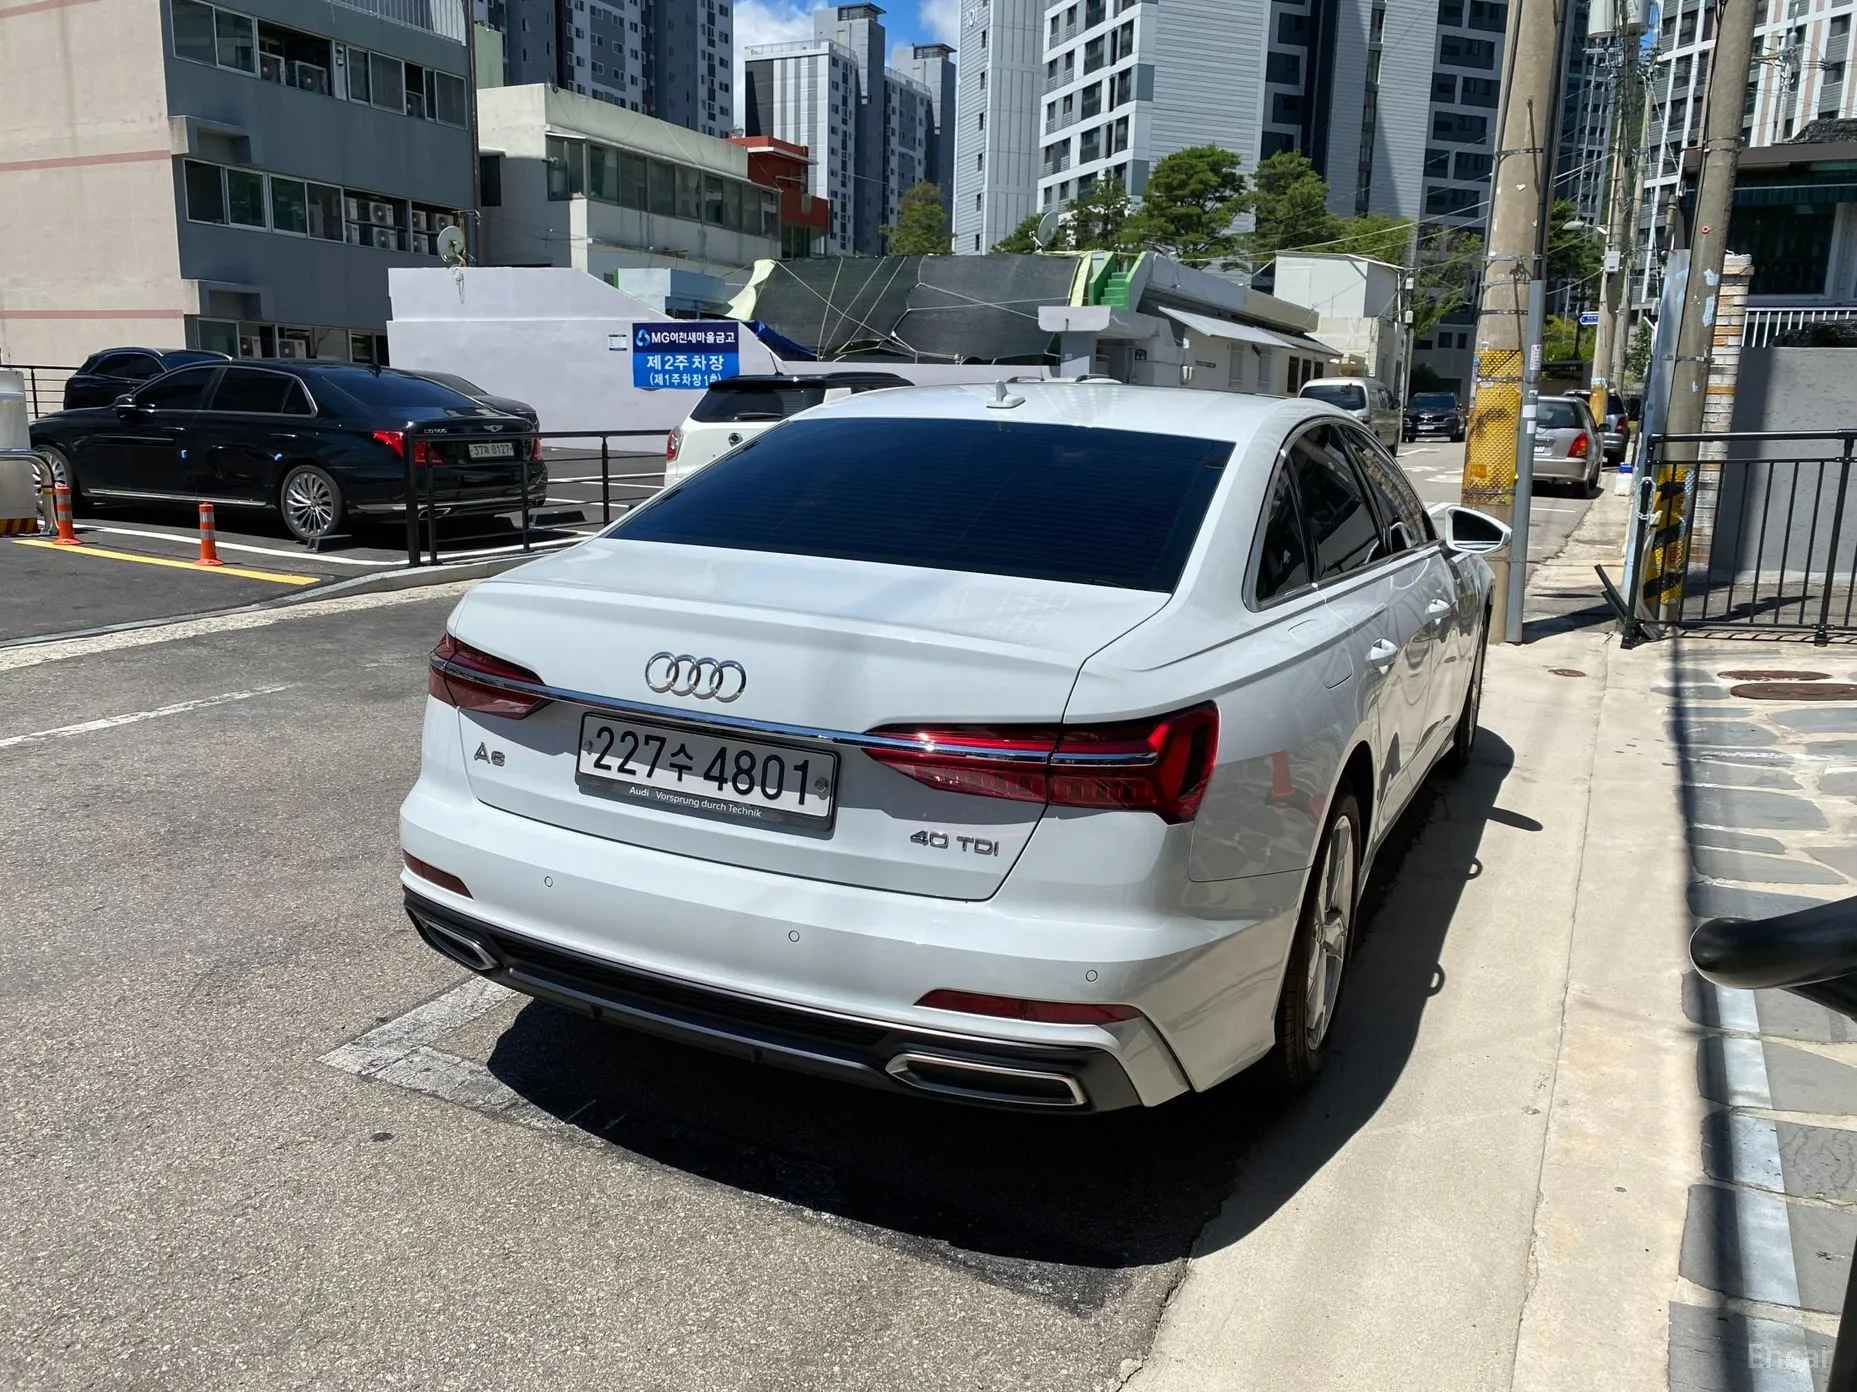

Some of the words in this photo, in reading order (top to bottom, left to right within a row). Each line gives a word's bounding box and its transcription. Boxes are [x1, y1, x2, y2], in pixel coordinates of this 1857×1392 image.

[651, 331, 736, 344] MG여천새마을금고
[491, 444, 510, 454] 0127
[473, 741, 506, 767] A6
[593, 726, 809, 806] 227수4801
[629, 786, 650, 798] Audi
[655, 790, 700, 808] Vorsprung
[701, 798, 728, 812] durch
[728, 803, 763, 818] Technik
[910, 830, 949, 850] 40
[956, 835, 1000, 858] TDI
